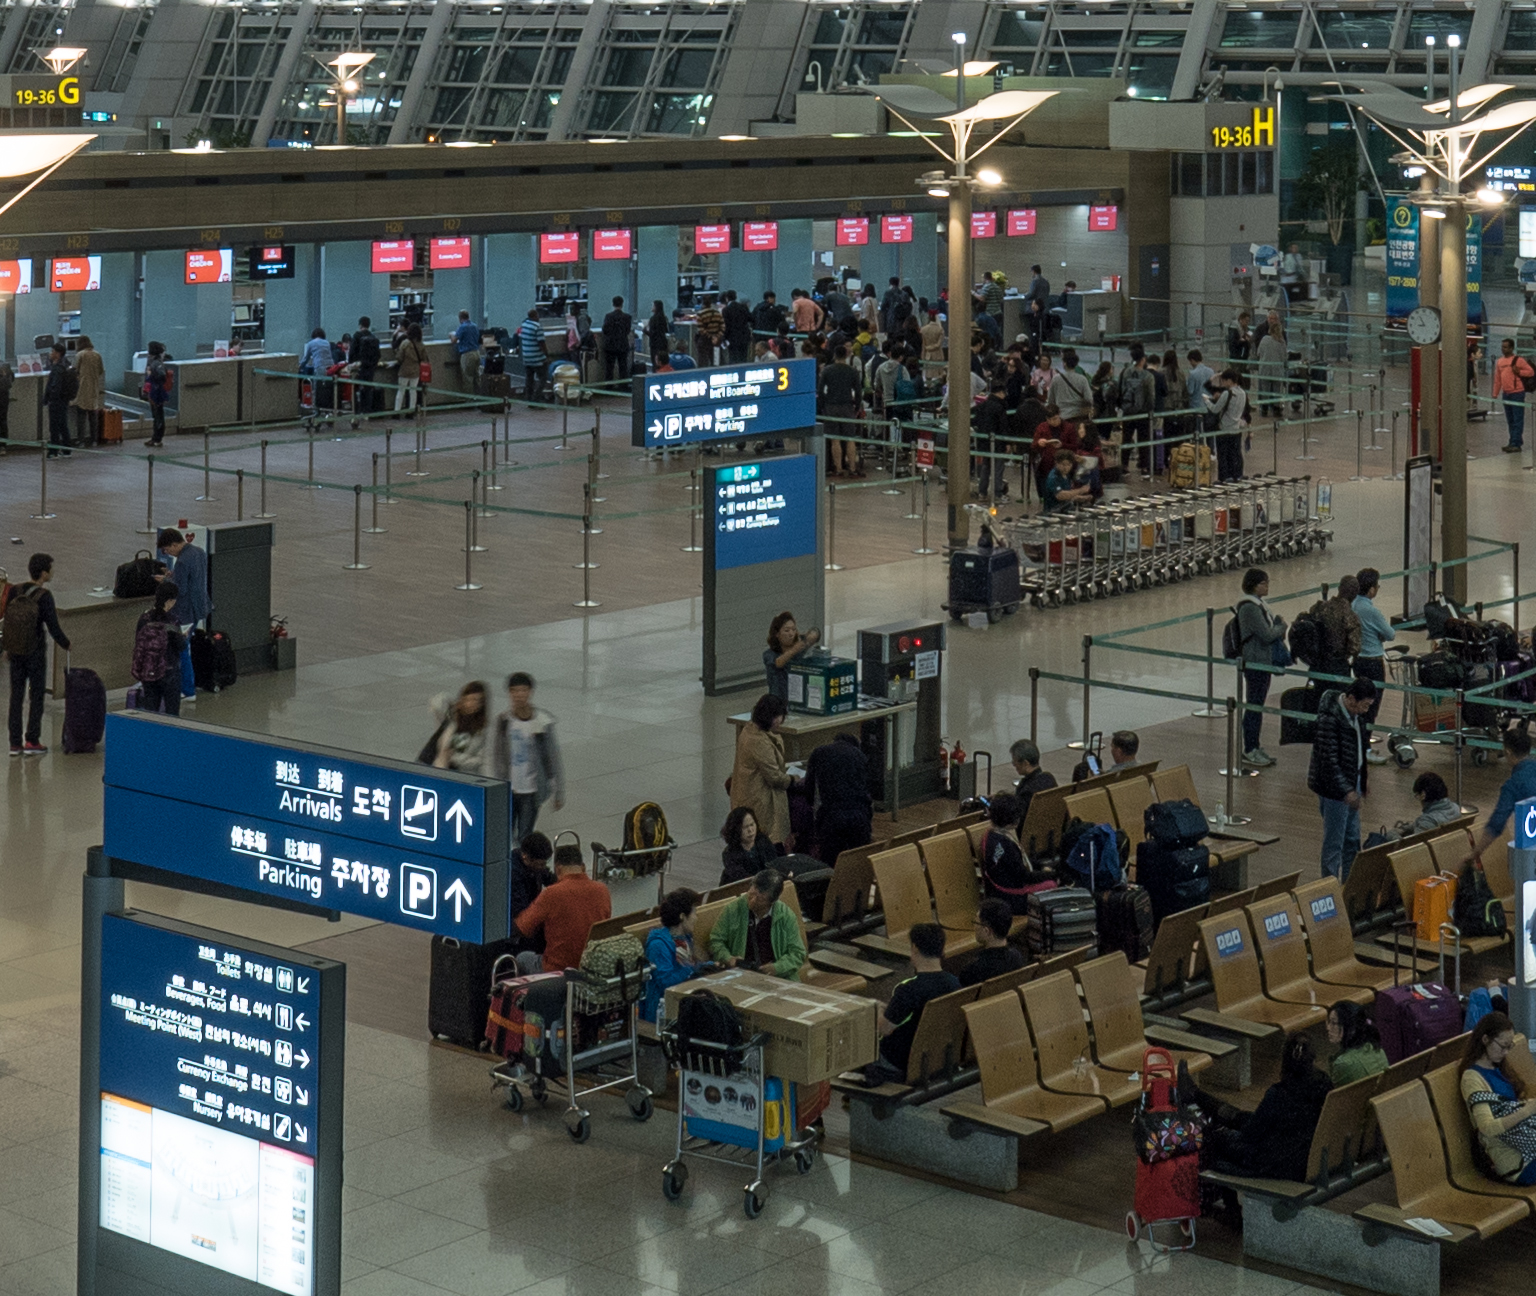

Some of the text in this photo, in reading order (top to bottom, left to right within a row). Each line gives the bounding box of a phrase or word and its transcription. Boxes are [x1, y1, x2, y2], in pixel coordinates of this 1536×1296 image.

[15, 77, 81, 106] 19-36 G
[1212, 106, 1275, 148] 19-36 H
[200, 230, 221, 242] H24
[265, 227, 284, 239] H25
[444, 218, 462, 230] H27
[67, 237, 89, 248] H23
[1389, 239, 1415, 251] 인천공항
[1389, 250, 1415, 261] 대표번호
[777, 367, 789, 391] 3
[709, 384, 761, 400] Int'l Boarding
[714, 420, 746, 434] Parking
[275, 760, 301, 785] 到达
[317, 768, 344, 794] 到着
[279, 790, 343, 822] Arrivals
[352, 785, 392, 821] 도착
[230, 825, 268, 853] 停车场
[284, 837, 322, 866] 駐車場
[259, 859, 323, 899] Parking
[330, 857, 391, 899] 주차장
[215, 962, 242, 980] Toilets
[244, 960, 273, 984] 화장실
[165, 985, 227, 1013] Beverages, Food
[229, 994, 273, 1022] 음료, 식사
[124, 1009, 203, 1043] Meeting Point (West)
[176, 1060, 212, 1082] Currency
[211, 1070, 249, 1093] Exchange
[192, 1100, 223, 1123] Nursery
